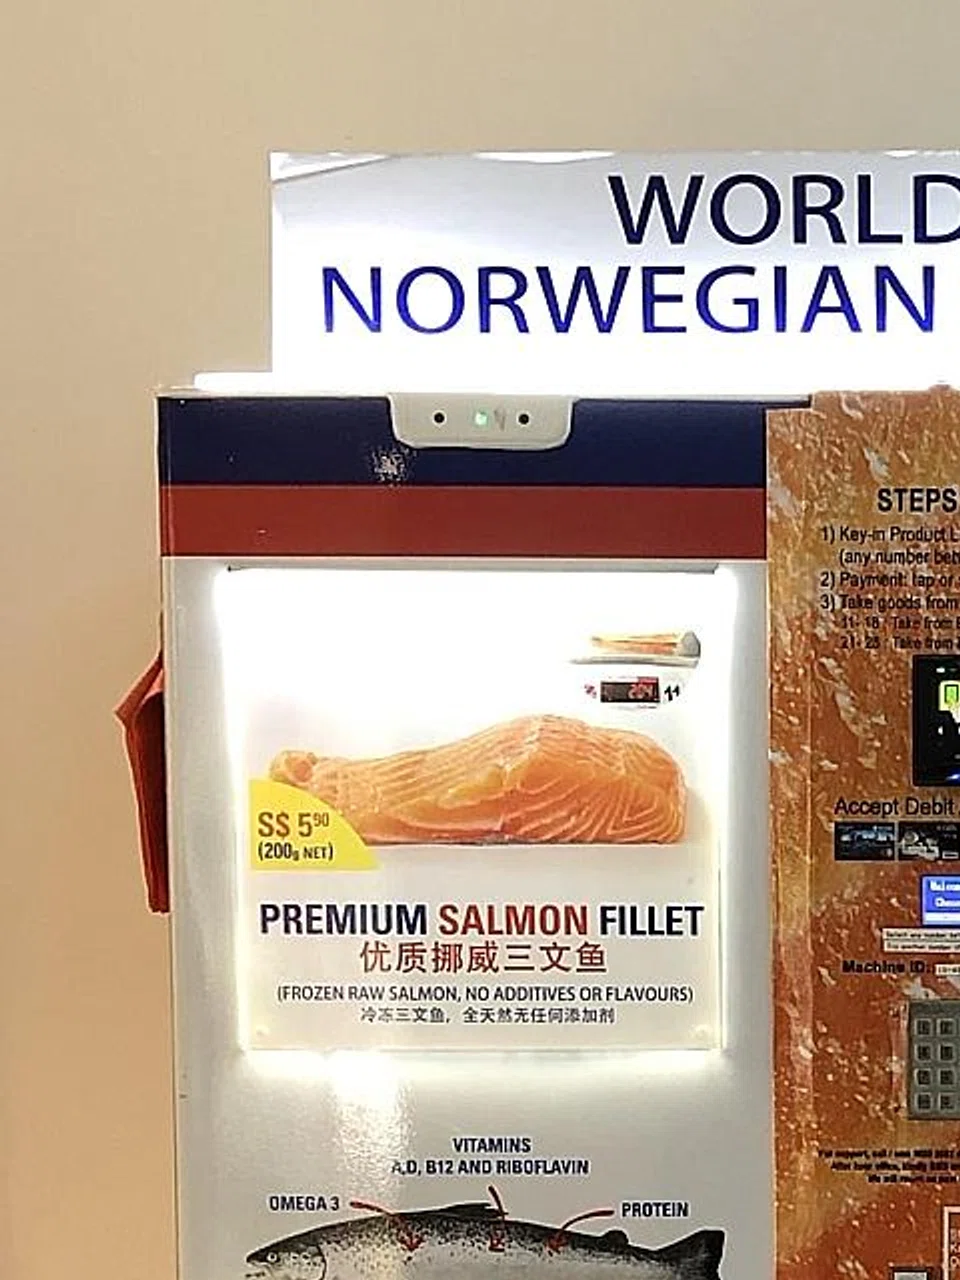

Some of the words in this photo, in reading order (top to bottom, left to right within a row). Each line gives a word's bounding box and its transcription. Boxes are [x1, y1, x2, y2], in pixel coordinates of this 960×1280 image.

[321, 266, 936, 336] NORWEGIAN
[878, 488, 957, 513] STEPS
[821, 527, 835, 542] 1)
[839, 527, 885, 543] Key-in
[889, 527, 946, 542] Product
[839, 550, 872, 567] (any
[876, 550, 929, 565] number
[821, 573, 835, 589] 2)
[912, 575, 935, 589] tap
[938, 576, 953, 587] or
[821, 595, 835, 611] 3)
[840, 596, 872, 610] Take
[878, 596, 921, 612] goods
[925, 595, 959, 610] from
[835, 799, 899, 817] Accept
[906, 799, 956, 815] Debit
[303, 843, 334, 860] NET)
[260, 903, 427, 935] PREMIUM
[439, 904, 588, 935] SALMON
[600, 906, 704, 935] FILLET
[360, 942, 607, 974] 优质挪威三文鱼
[277, 987, 344, 1001] (FROZEN
[348, 987, 385, 1001] RAW
[389, 987, 461, 1002] SALMON,
[466, 987, 489, 1001] NO
[494, 986, 575, 1001] ADDITIVES
[580, 986, 601, 1001] OR
[605, 986, 693, 1002] FLAVOURS)
[453, 1138, 531, 1153] VITAMINS
[426, 1160, 454, 1175] B12
[458, 1160, 492, 1174] AND
[496, 1159, 589, 1175] RIBOFLAVIN
[270, 1197, 327, 1211] OMEGA
[330, 1197, 339, 1211] 3
[622, 1203, 688, 1217] PROTEIN
